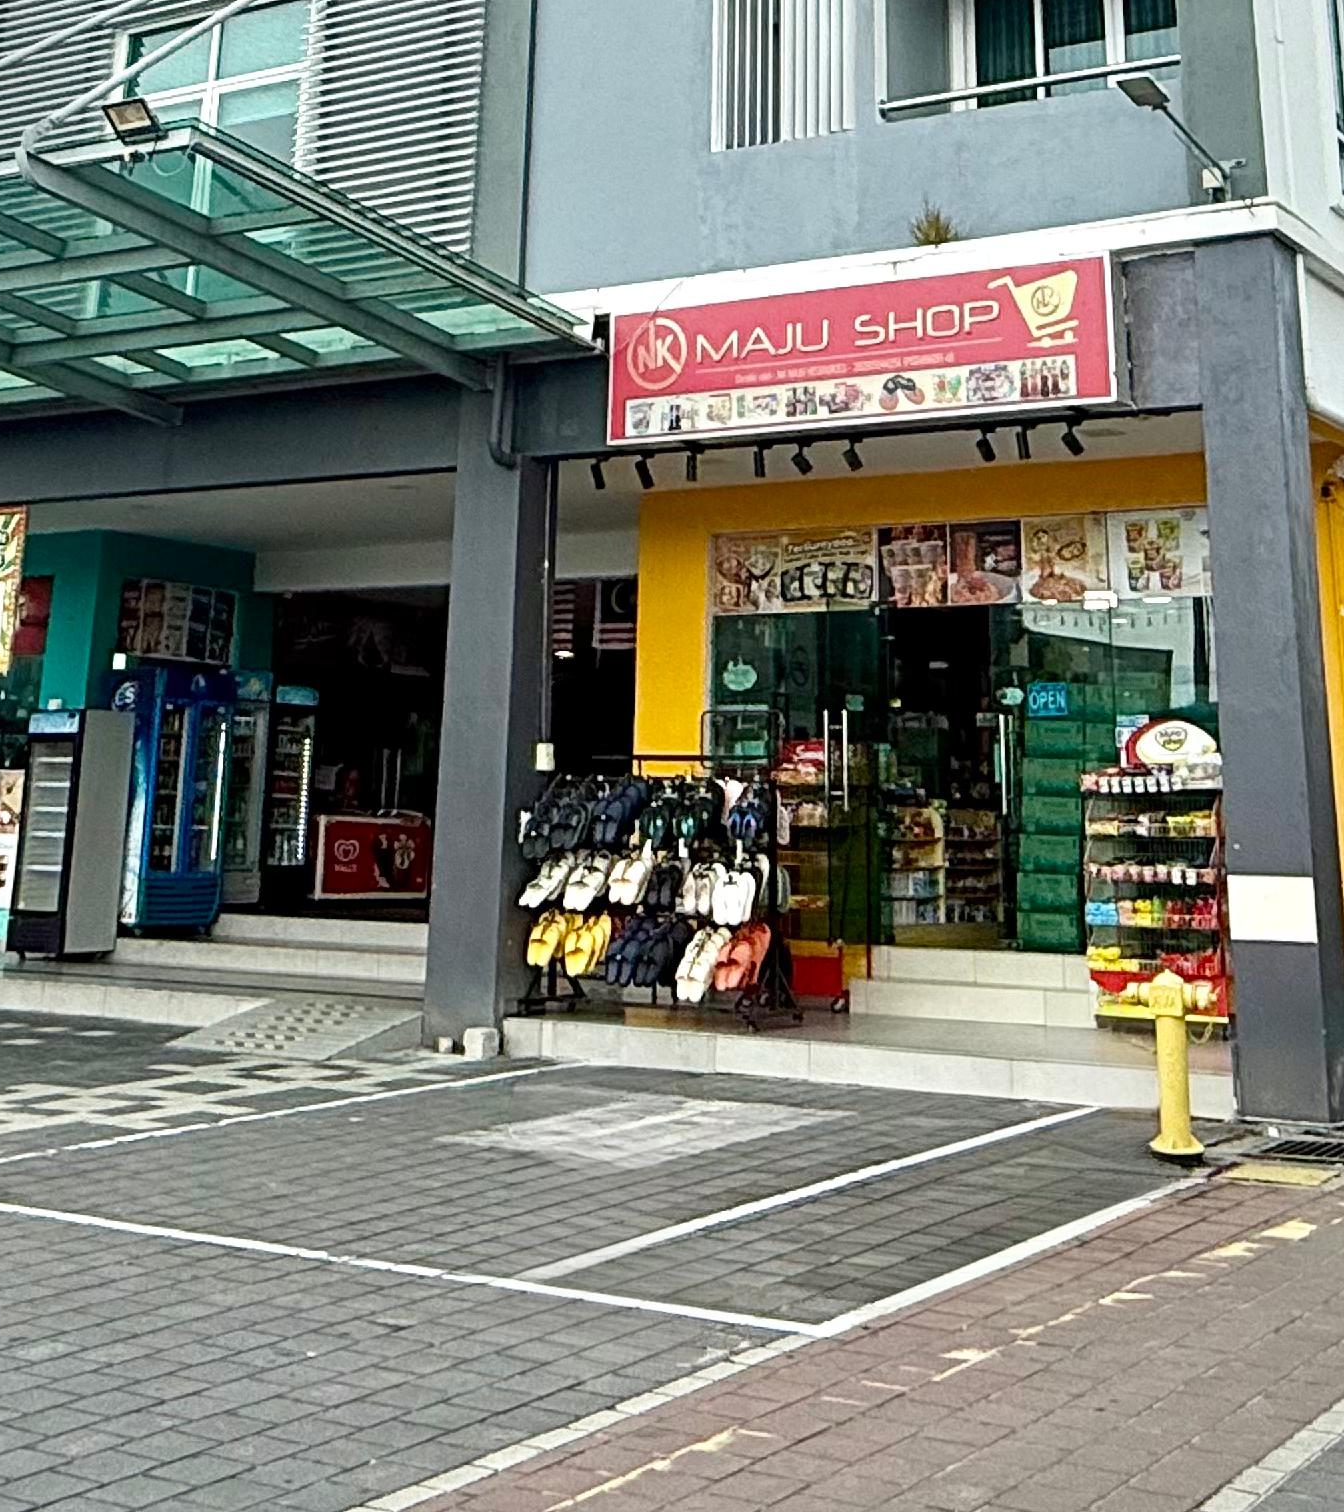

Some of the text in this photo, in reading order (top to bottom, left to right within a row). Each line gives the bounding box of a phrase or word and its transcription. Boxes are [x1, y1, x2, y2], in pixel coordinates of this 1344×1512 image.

[695, 319, 830, 365] MAJU
[853, 300, 1001, 347] SHOP
[1029, 690, 1066, 710] OPEN
